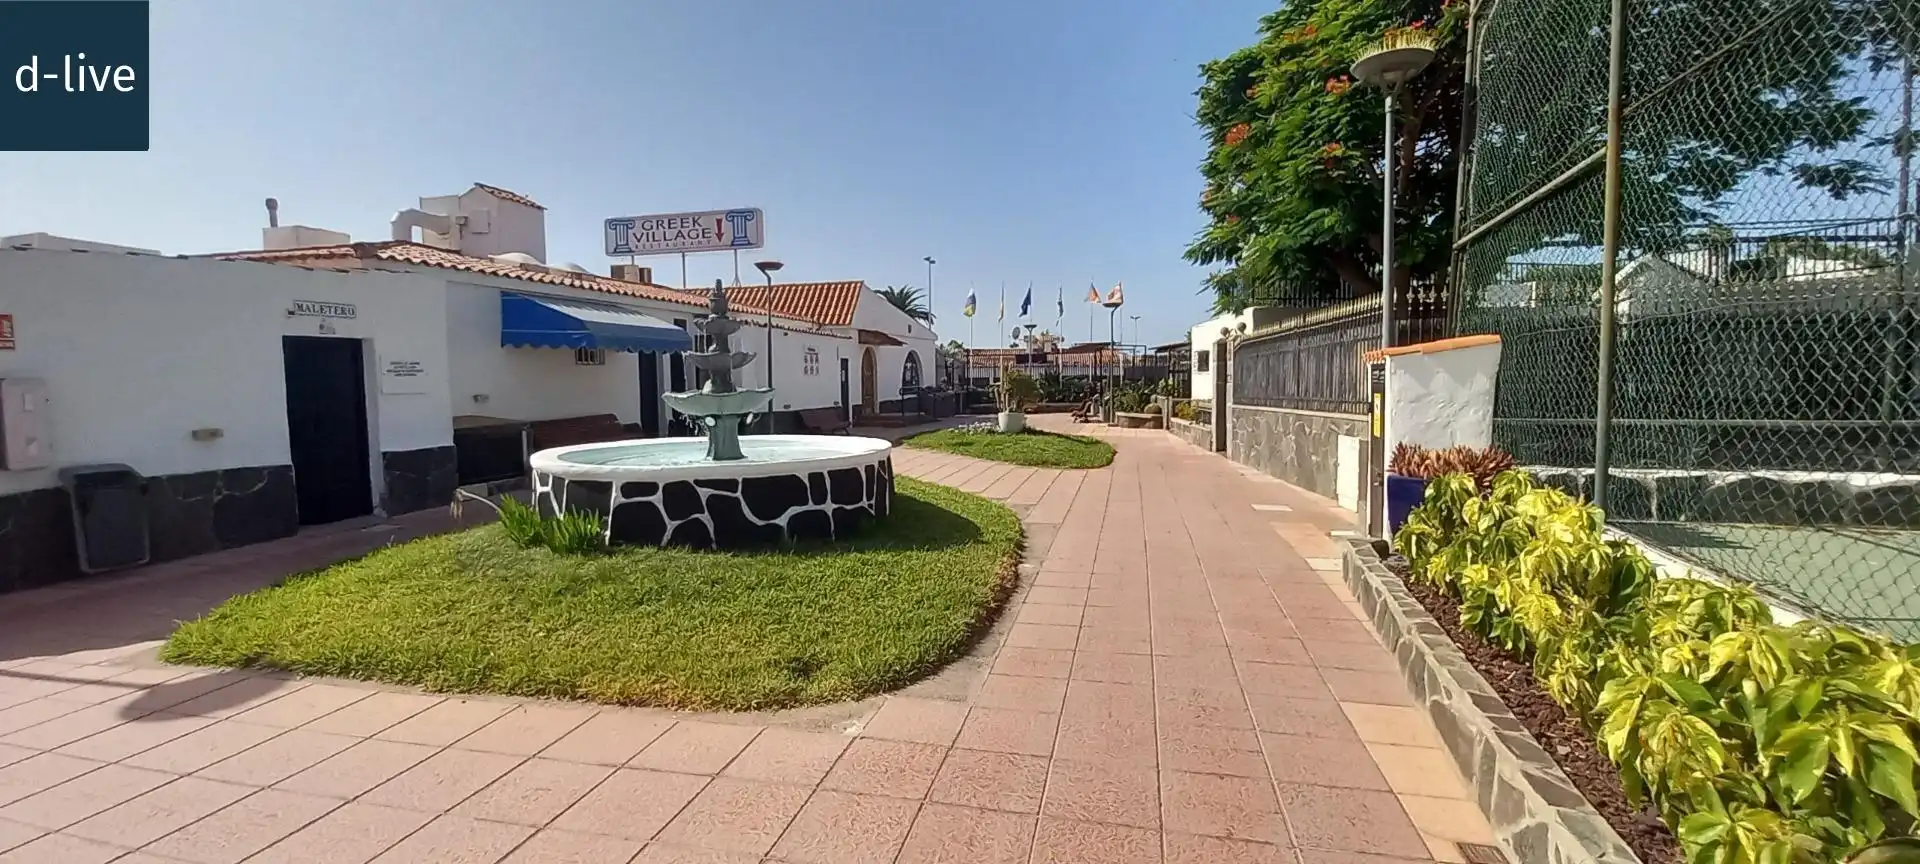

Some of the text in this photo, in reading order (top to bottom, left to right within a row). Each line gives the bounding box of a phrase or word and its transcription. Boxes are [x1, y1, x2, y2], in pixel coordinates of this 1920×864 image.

[641, 216, 703, 231] GREEK
[632, 227, 712, 243] VILLAGE
[635, 239, 712, 249] RESTAURANT
[296, 302, 355, 316] MALETERO
